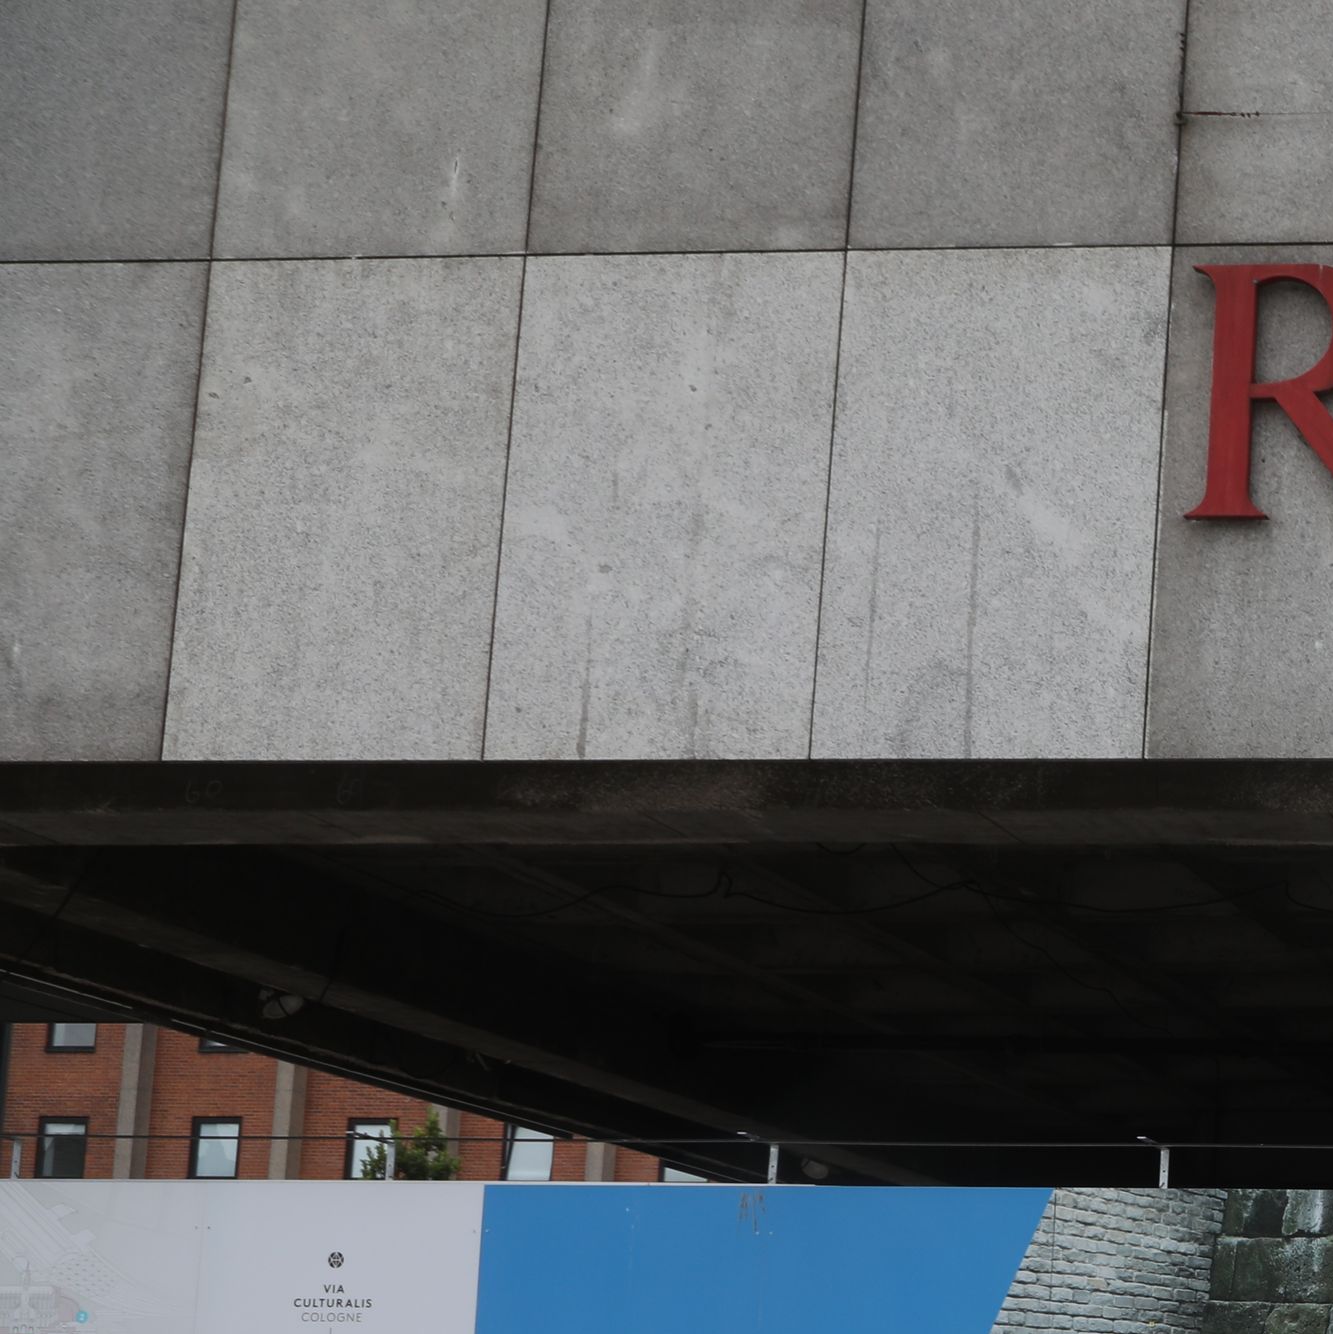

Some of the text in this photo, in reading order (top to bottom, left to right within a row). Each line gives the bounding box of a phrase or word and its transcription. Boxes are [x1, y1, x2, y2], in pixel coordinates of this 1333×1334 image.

[324, 1285, 344, 1293] VIA
[294, 1298, 372, 1308] CULTURALIS
[301, 1312, 362, 1323] COLOGNE
